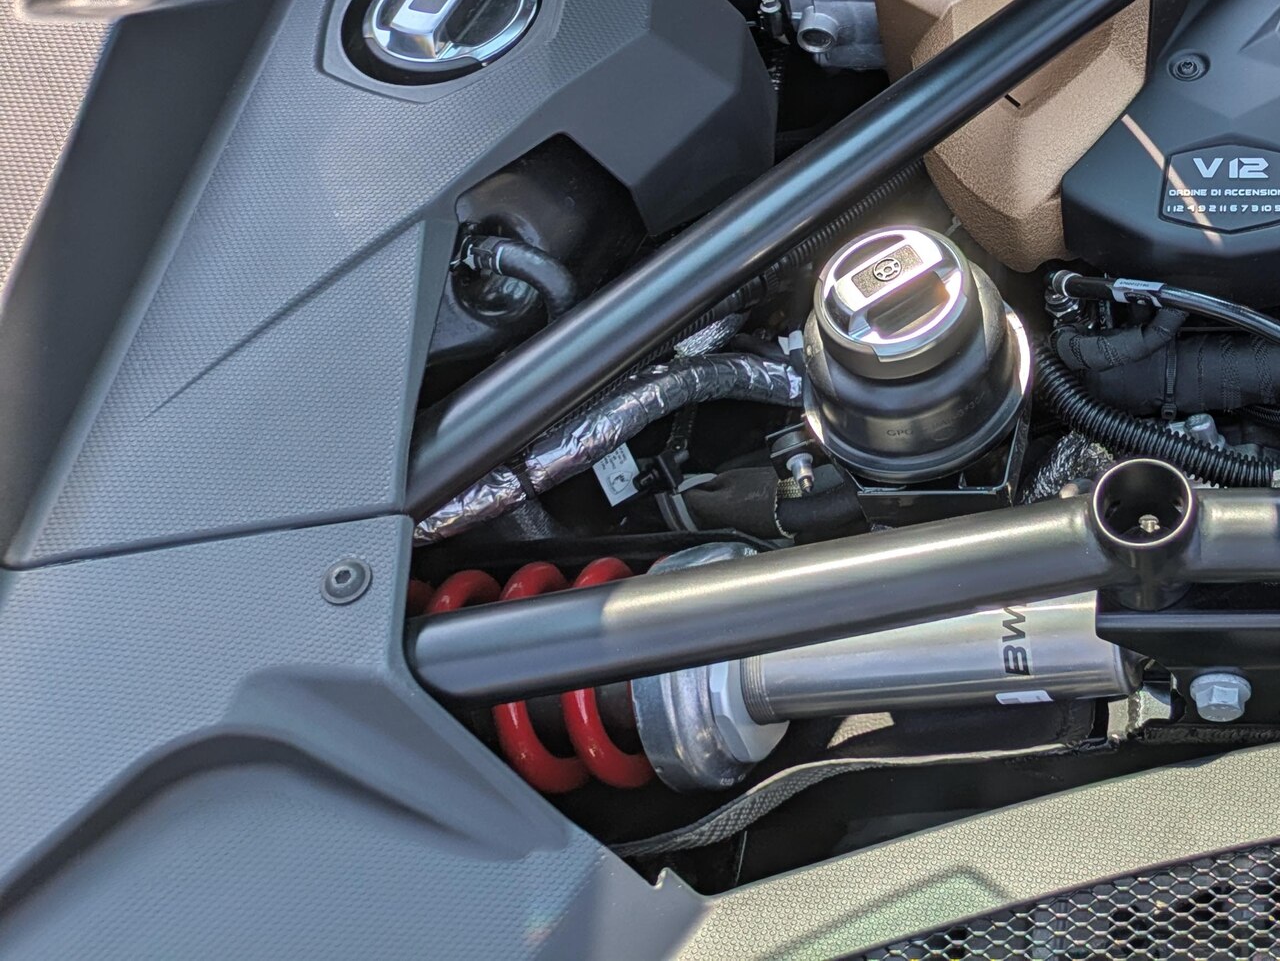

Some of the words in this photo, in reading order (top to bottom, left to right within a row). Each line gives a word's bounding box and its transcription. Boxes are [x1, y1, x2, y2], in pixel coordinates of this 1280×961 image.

[1192, 157, 1269, 179] V12
[1168, 189, 1207, 197] ORDINE
[1173, 204, 1184, 212] 12
[1187, 204, 1195, 212] 4
[1208, 204, 1217, 212] 2
[1219, 204, 1227, 212] 11
[1229, 204, 1238, 212] 6
[1241, 204, 1249, 212] 7
[1261, 204, 1272, 212] 10
[1002, 606, 1031, 676] BW
